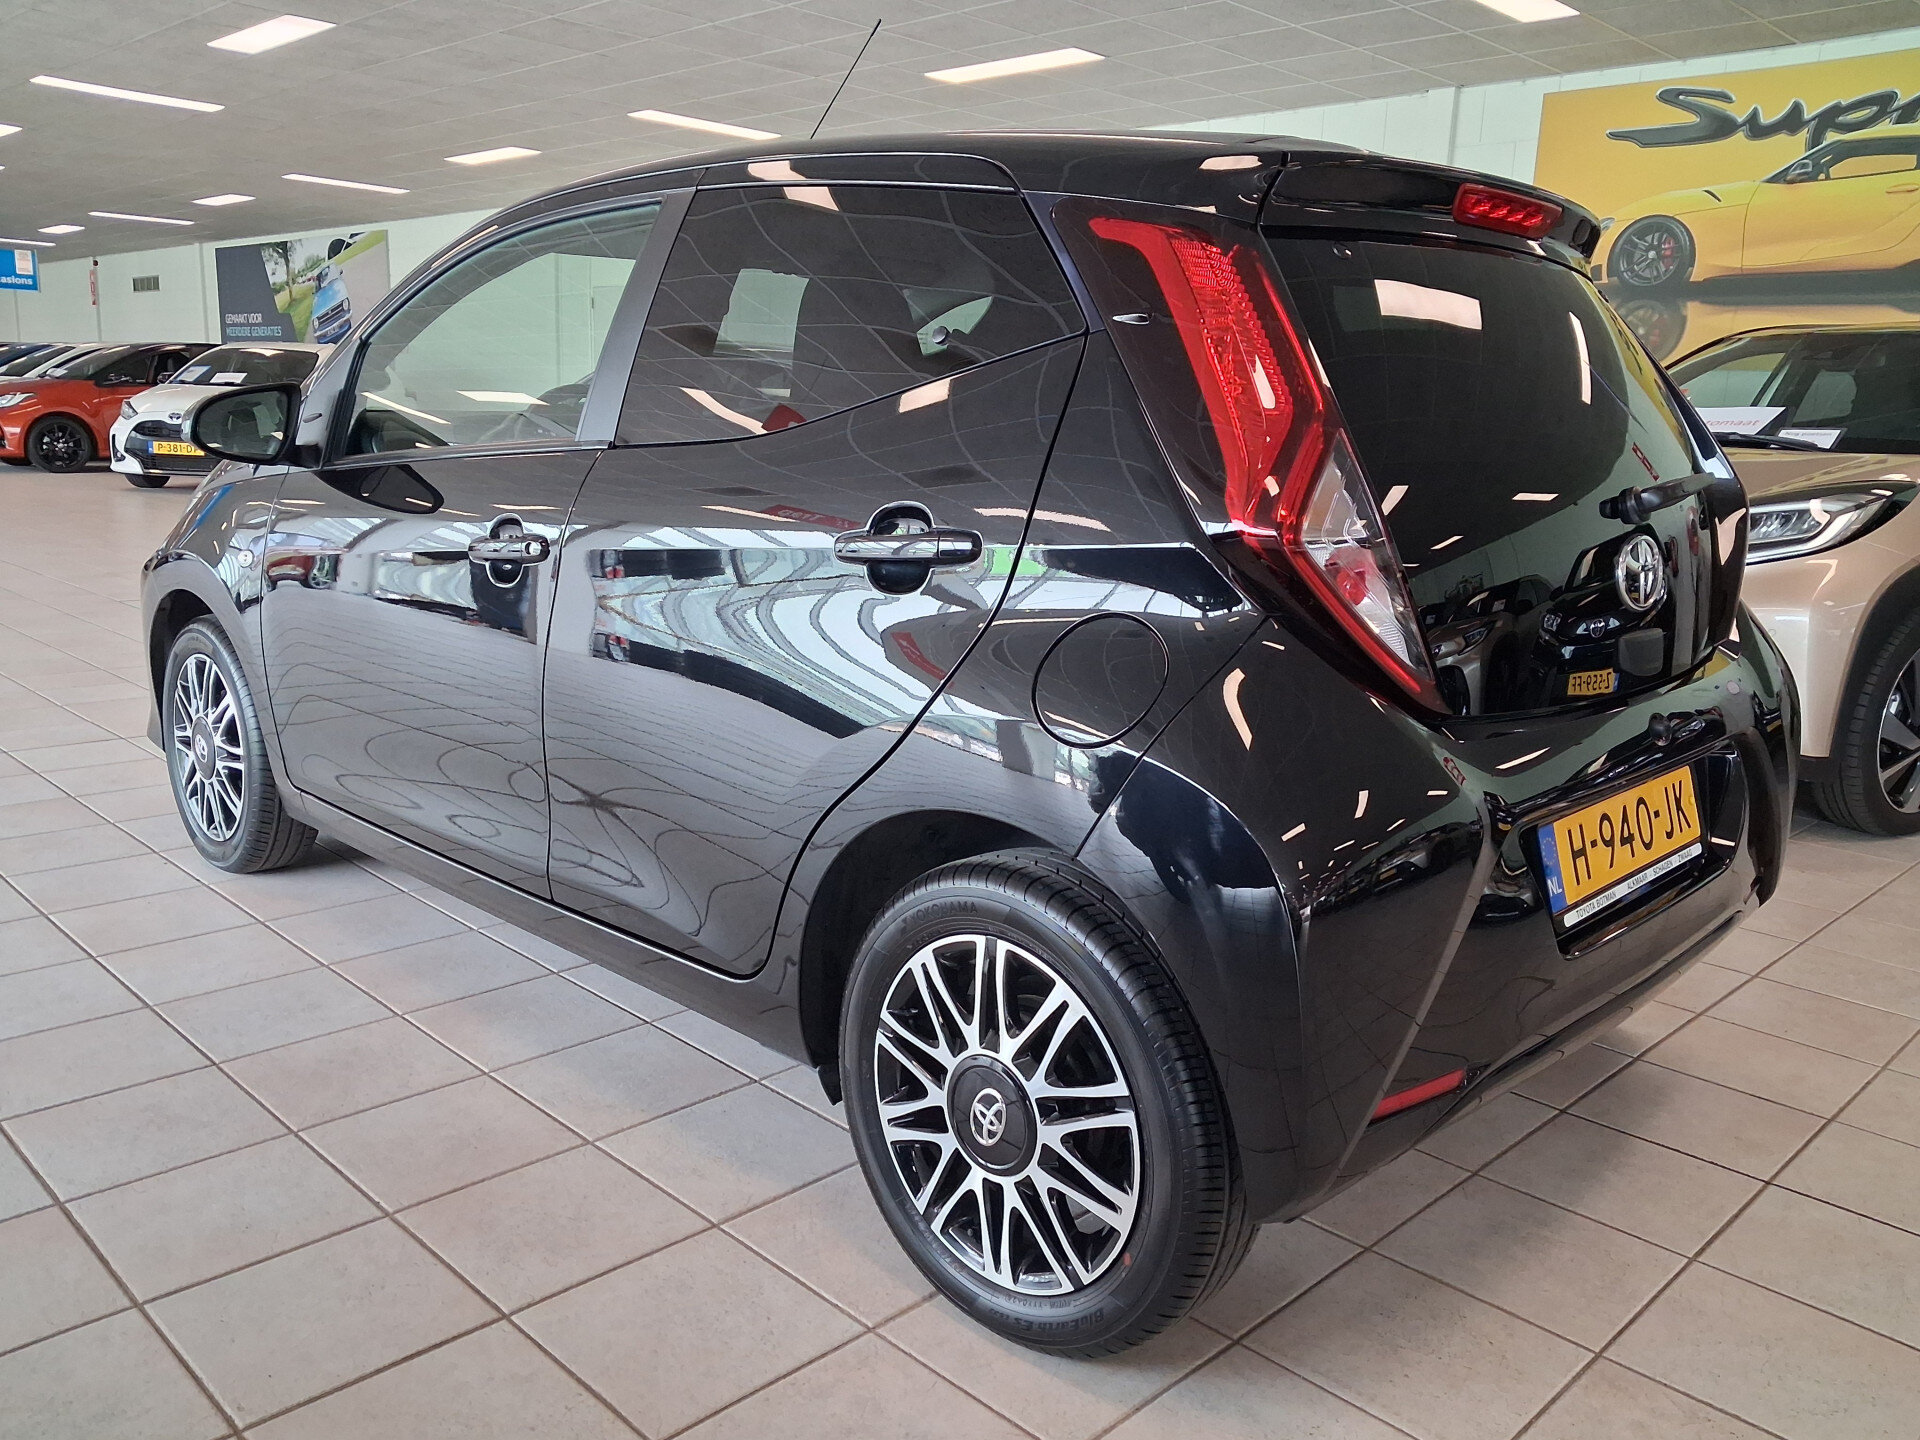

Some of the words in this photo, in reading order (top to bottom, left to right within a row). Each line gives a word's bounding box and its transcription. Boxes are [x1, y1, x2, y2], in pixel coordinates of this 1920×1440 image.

[0, 275, 33, 285] asions
[248, 313, 263, 324] VOOR
[251, 326, 282, 337] GENERATIES
[1567, 780, 1692, 886] H-940-JK
[1547, 876, 1563, 897] NL
[1575, 904, 1596, 919] TOYOTA
[1596, 891, 1617, 908] BOTMAN
[1627, 872, 1648, 890] ALKMAAR
[1653, 861, 1673, 877] SCHAGEN
[908, 900, 978, 924] YOKOHAMA
